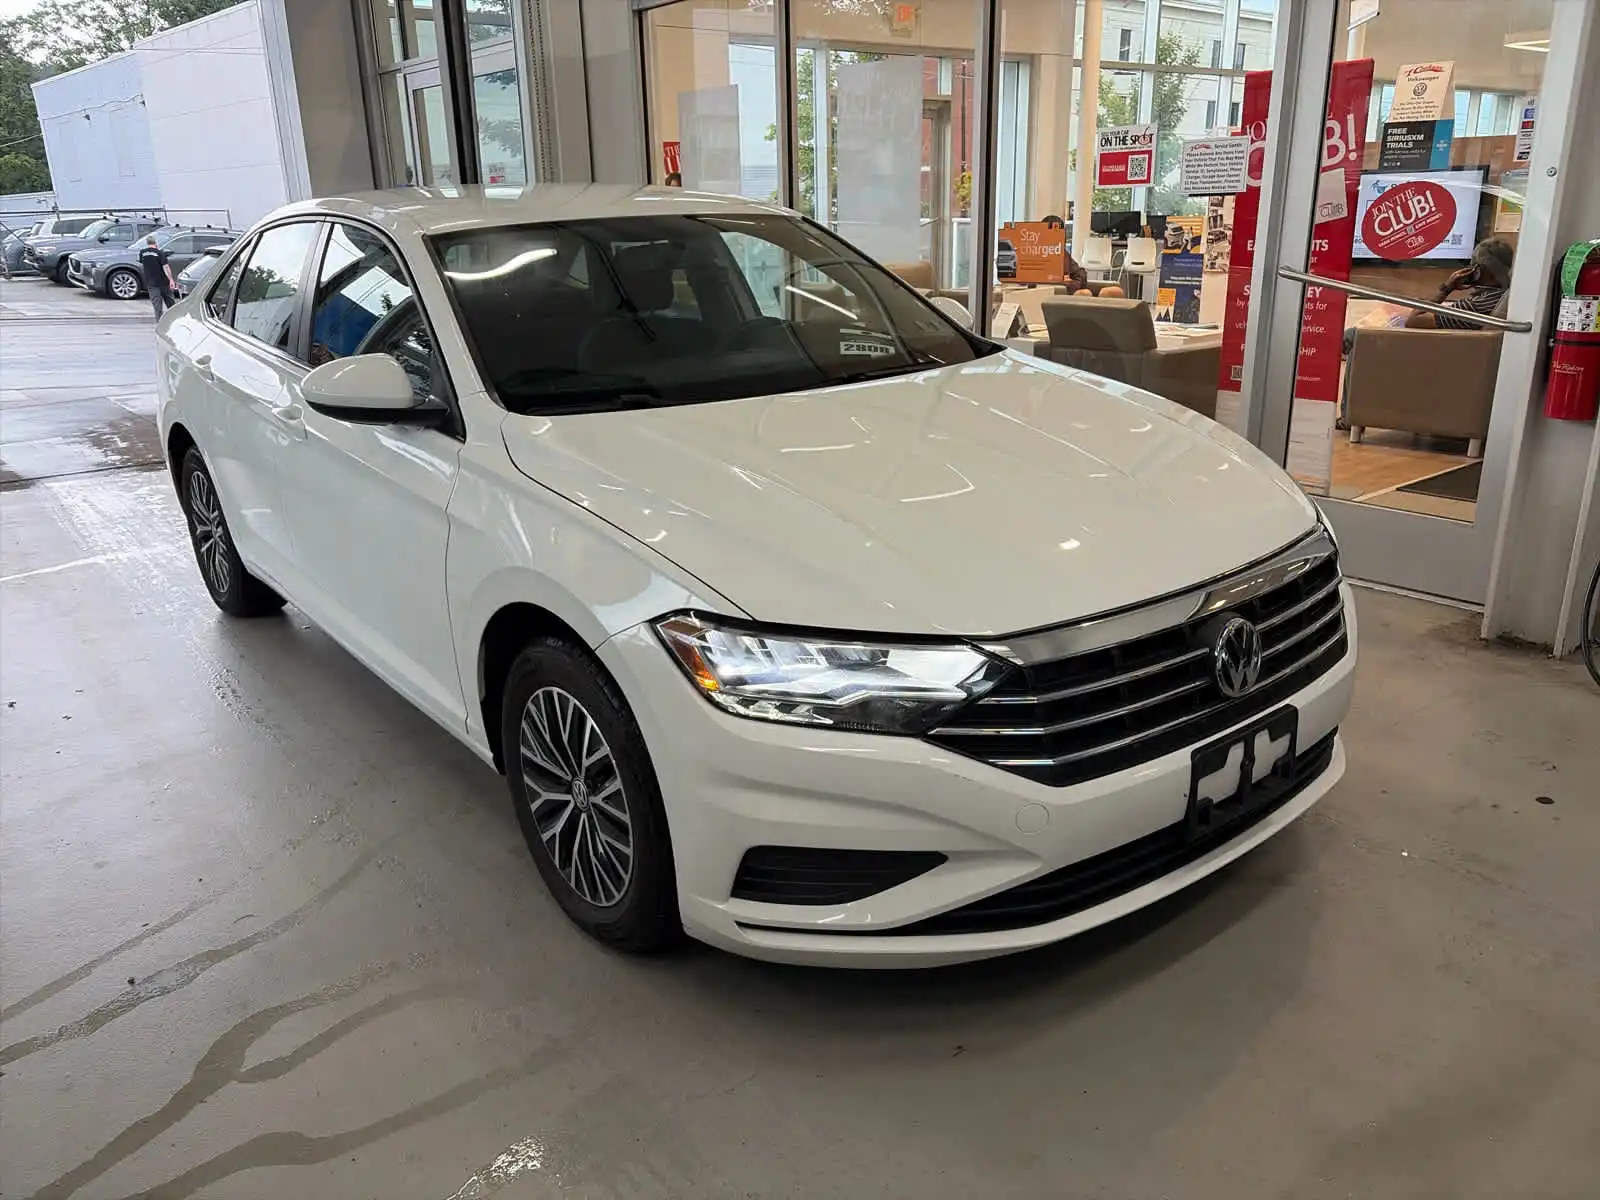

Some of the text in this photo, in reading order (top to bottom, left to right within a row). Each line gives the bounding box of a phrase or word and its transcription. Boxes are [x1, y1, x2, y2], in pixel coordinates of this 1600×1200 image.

[1100, 133, 1154, 147] ON THE SPOT
[1372, 187, 1418, 220] JOIN THE
[1374, 190, 1436, 236] CLUB!
[1020, 228, 1041, 245] Stay
[1020, 241, 1062, 258] charged
[1316, 301, 1327, 310] for
